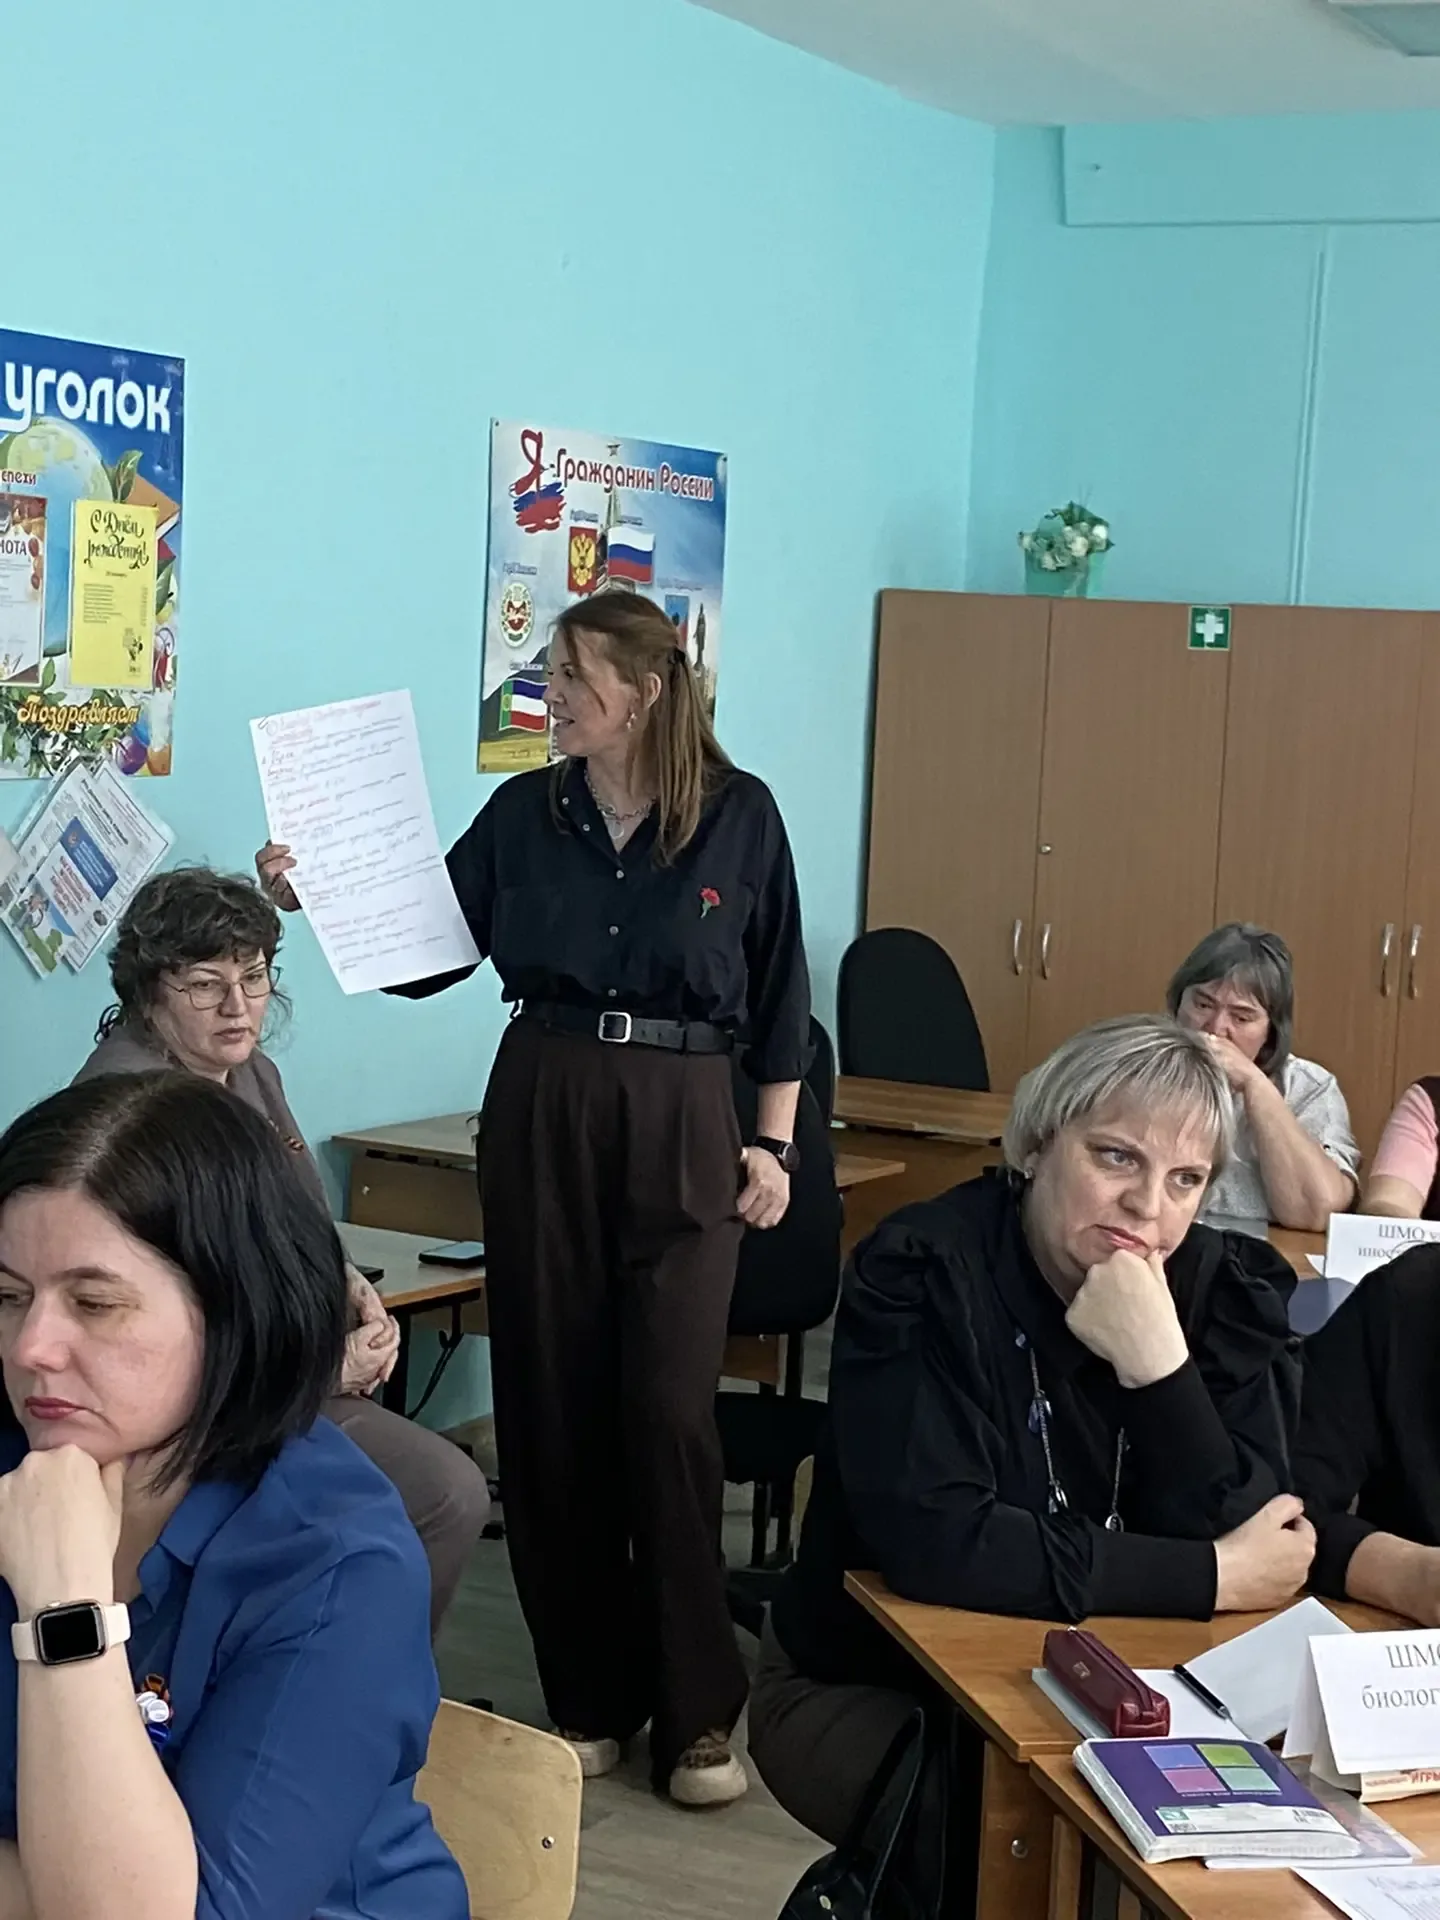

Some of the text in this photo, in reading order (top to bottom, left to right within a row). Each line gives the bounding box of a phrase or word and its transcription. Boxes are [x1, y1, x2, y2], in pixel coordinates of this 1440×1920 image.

[0, 362, 172, 434] уголок
[659, 462, 714, 501] России
[1378, 1224, 1425, 1241] ШМО
[1385, 1643, 1440, 1668] ШМ
